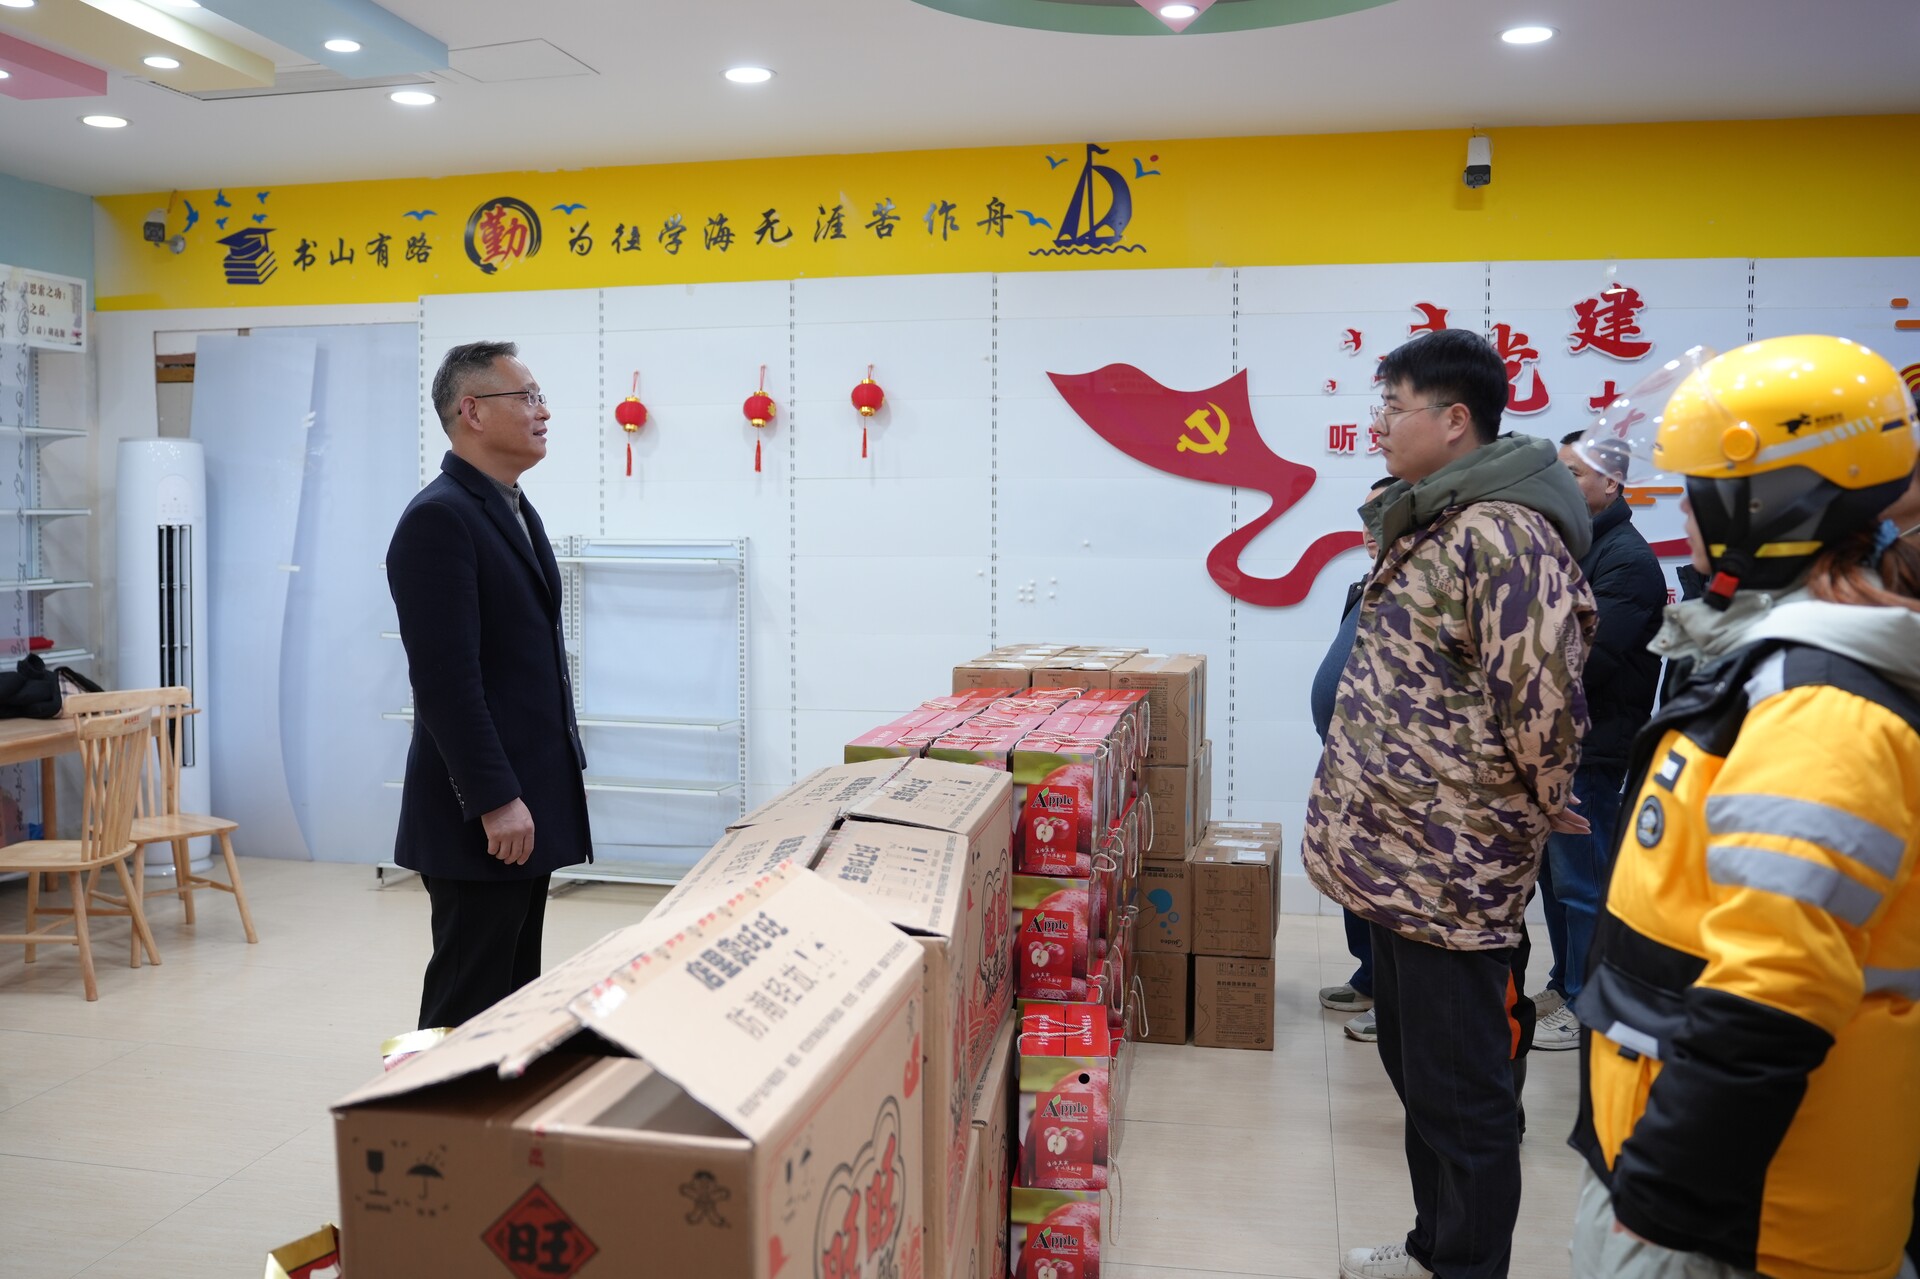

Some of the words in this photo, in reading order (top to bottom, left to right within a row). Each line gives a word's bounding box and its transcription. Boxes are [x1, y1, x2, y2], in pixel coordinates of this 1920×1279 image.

[293, 232, 433, 272] 书山有路
[479, 205, 528, 263] 勤
[1031, 790, 1073, 809] Apple
[1026, 915, 1069, 933] Apple
[1041, 1098, 1088, 1118] Apple
[507, 1219, 572, 1274] 旺
[1032, 1230, 1078, 1249] Apple
